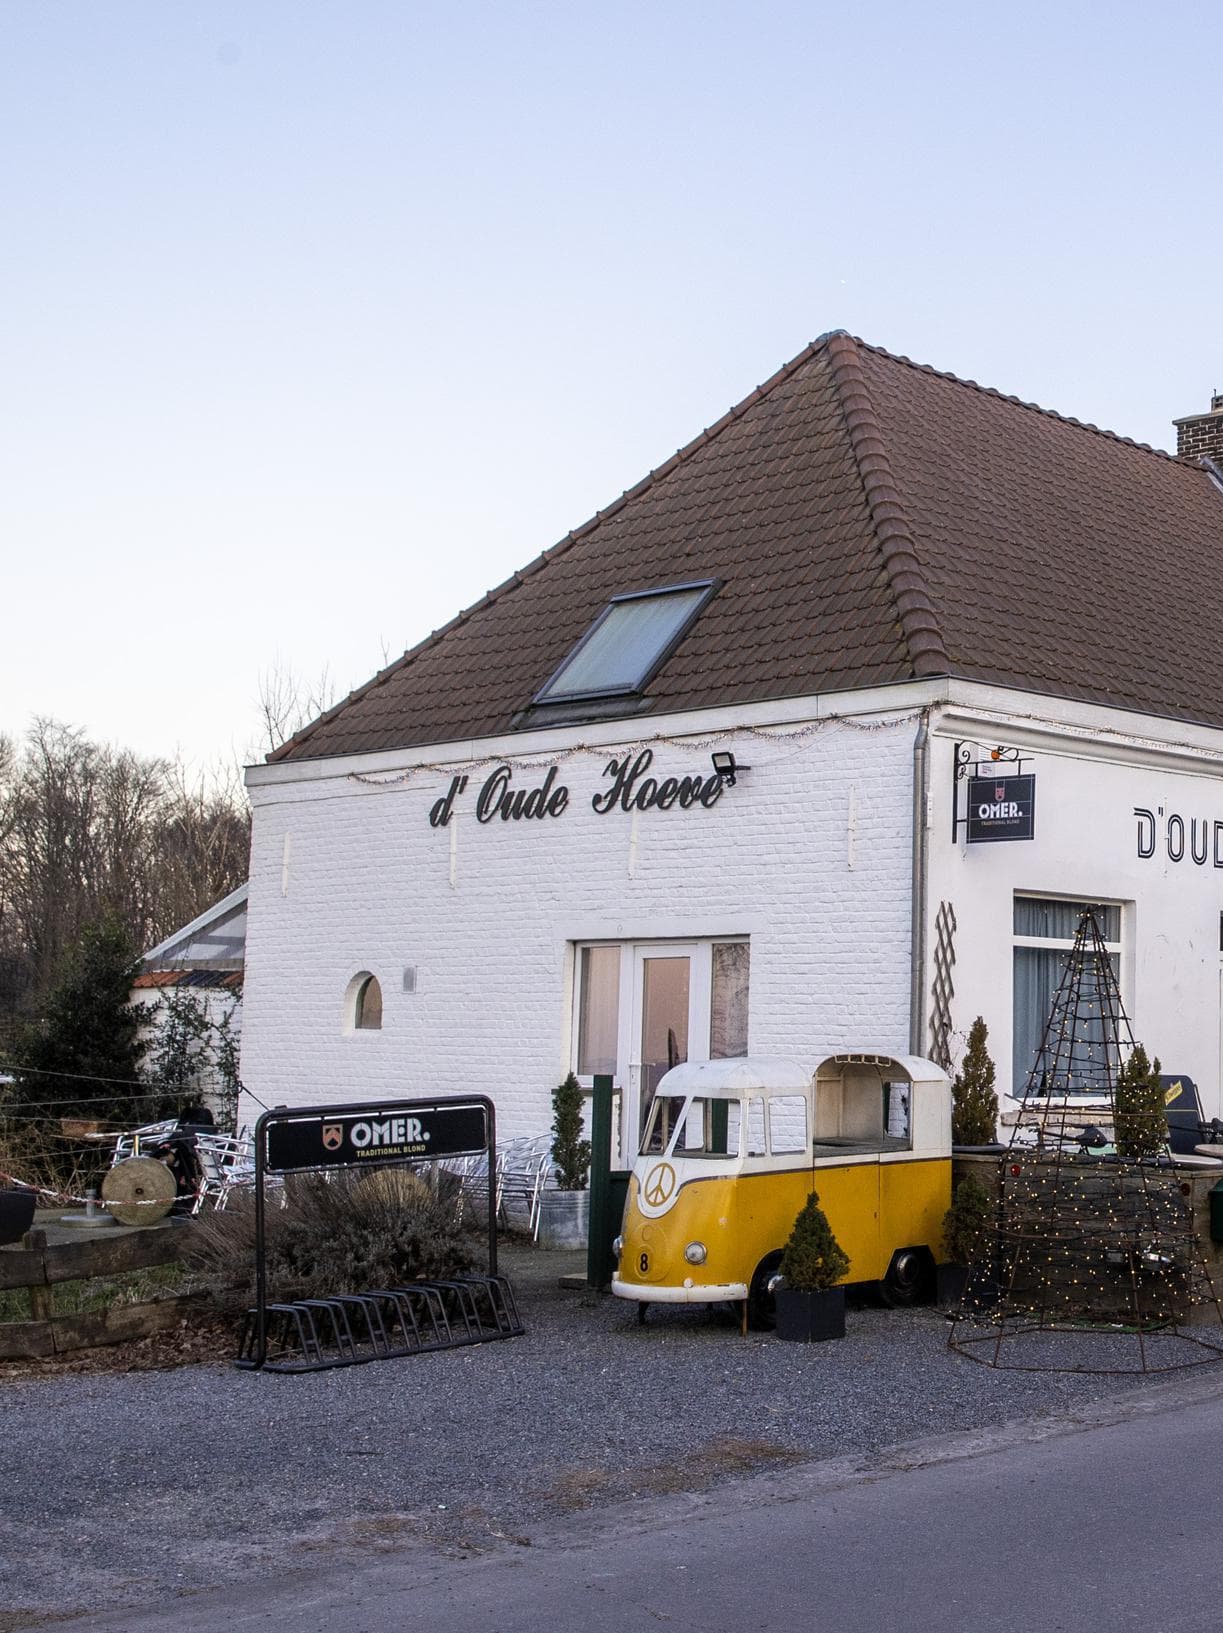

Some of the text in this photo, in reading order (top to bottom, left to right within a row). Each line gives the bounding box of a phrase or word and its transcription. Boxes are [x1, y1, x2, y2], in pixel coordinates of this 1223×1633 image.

[592, 749, 724, 814] Hoeve
[979, 801, 1023, 819] OMER.
[350, 1117, 431, 1147] OMER.
[356, 1144, 426, 1158] TRADITIONAL BLOND
[640, 1252, 649, 1272] 8
